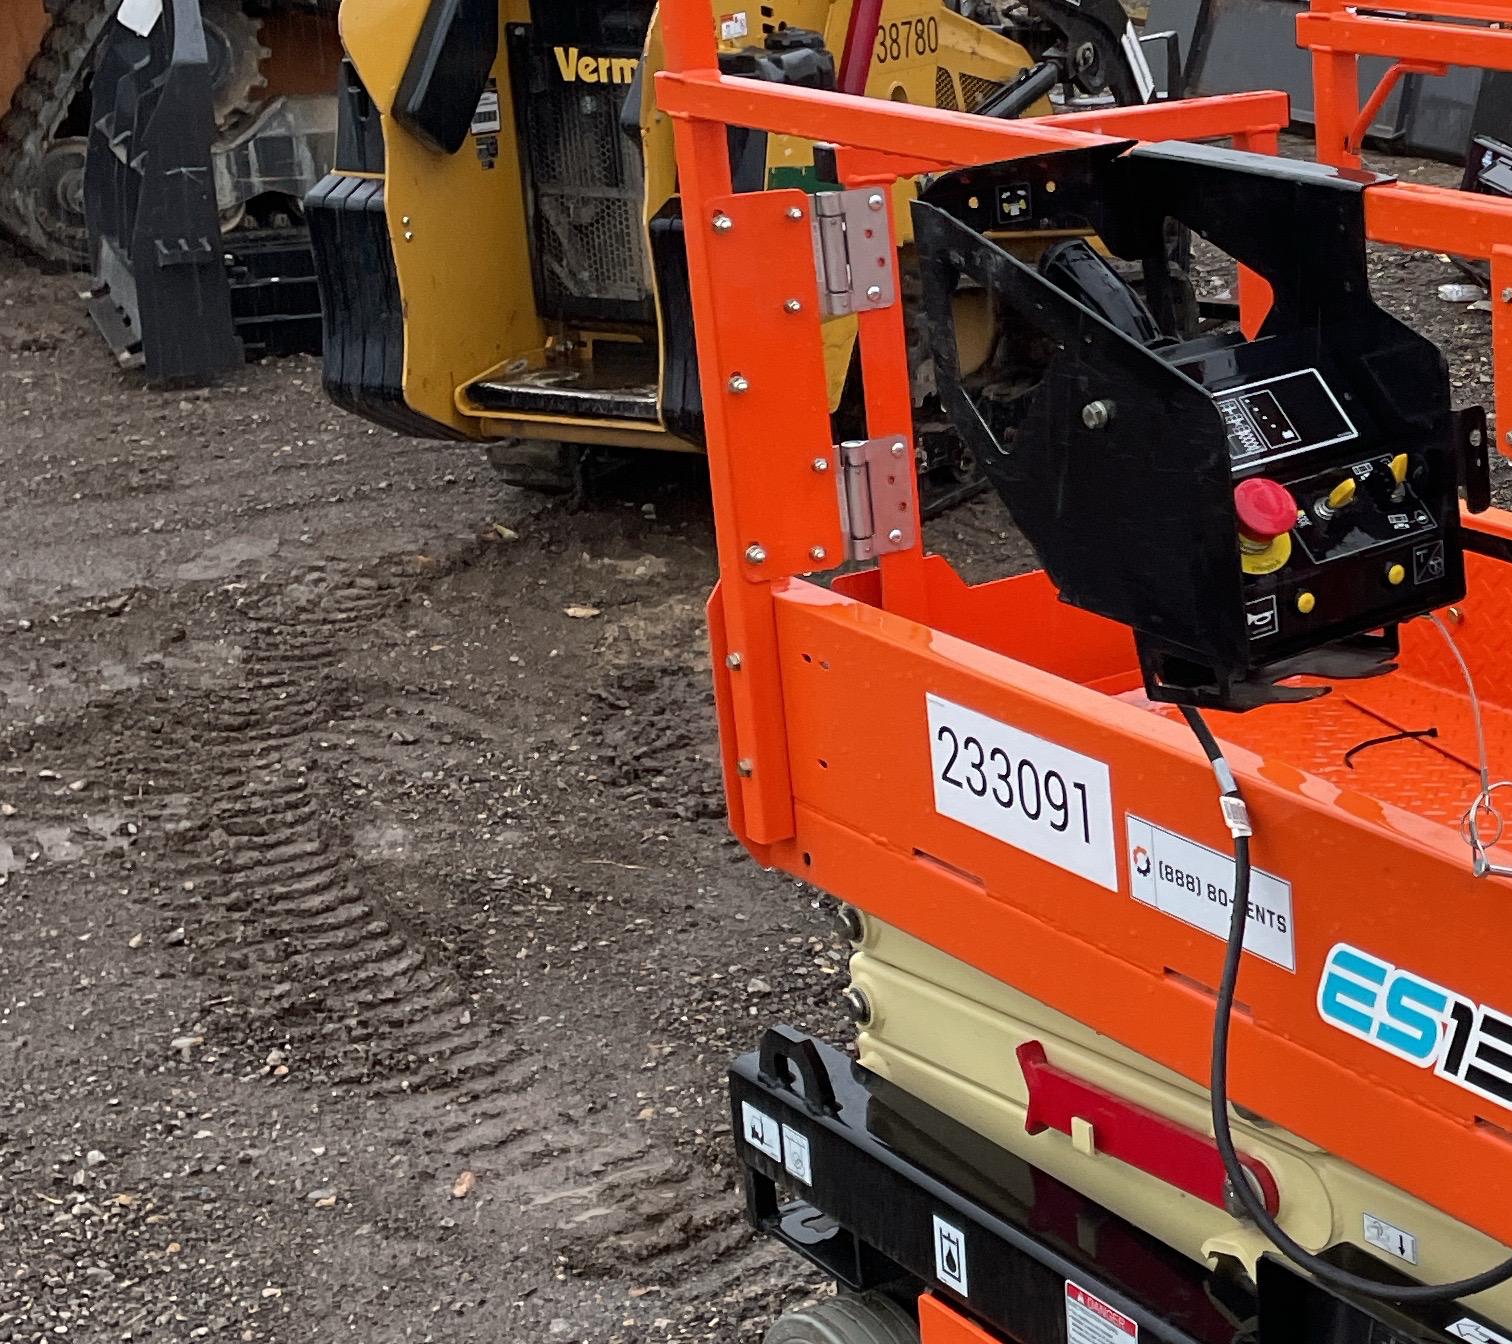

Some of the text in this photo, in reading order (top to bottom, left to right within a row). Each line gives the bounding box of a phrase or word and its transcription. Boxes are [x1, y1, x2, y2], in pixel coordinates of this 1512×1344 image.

[876, 16, 938, 64] 38780
[937, 724, 1091, 845] 233091
[1158, 860, 1288, 934] (888) 80-ENTS
[1086, 1297, 1126, 1326] DANGER
